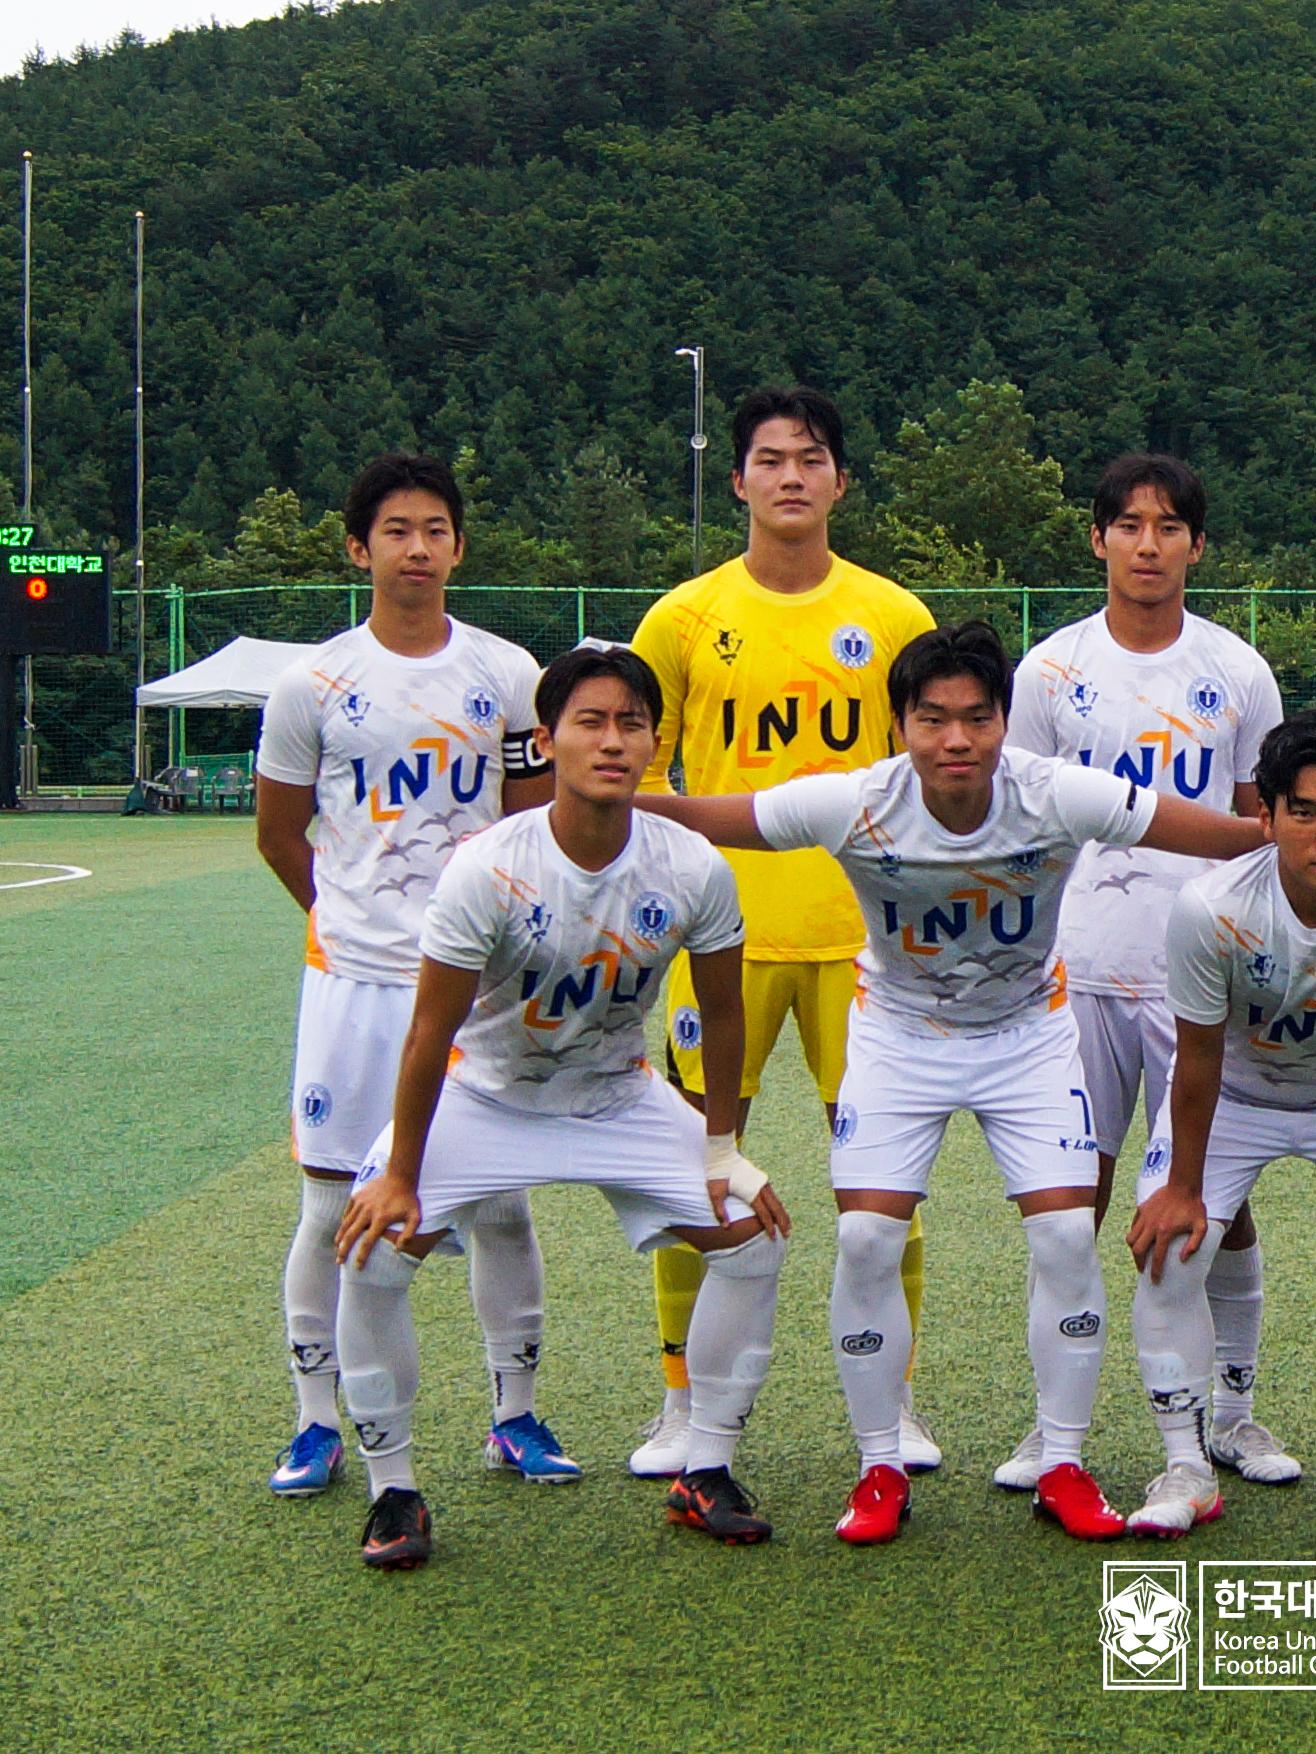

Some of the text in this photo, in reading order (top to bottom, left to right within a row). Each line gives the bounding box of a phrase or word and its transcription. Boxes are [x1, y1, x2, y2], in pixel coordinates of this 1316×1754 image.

[0, 527, 34, 547] :27
[9, 555, 104, 574] 인천대학교
[27, 577, 48, 599] 0
[724, 698, 860, 751] INU
[350, 753, 488, 806] INU
[881, 894, 1035, 946] INU
[519, 964, 656, 1018] INU
[1070, 1089, 1091, 1136] 7
